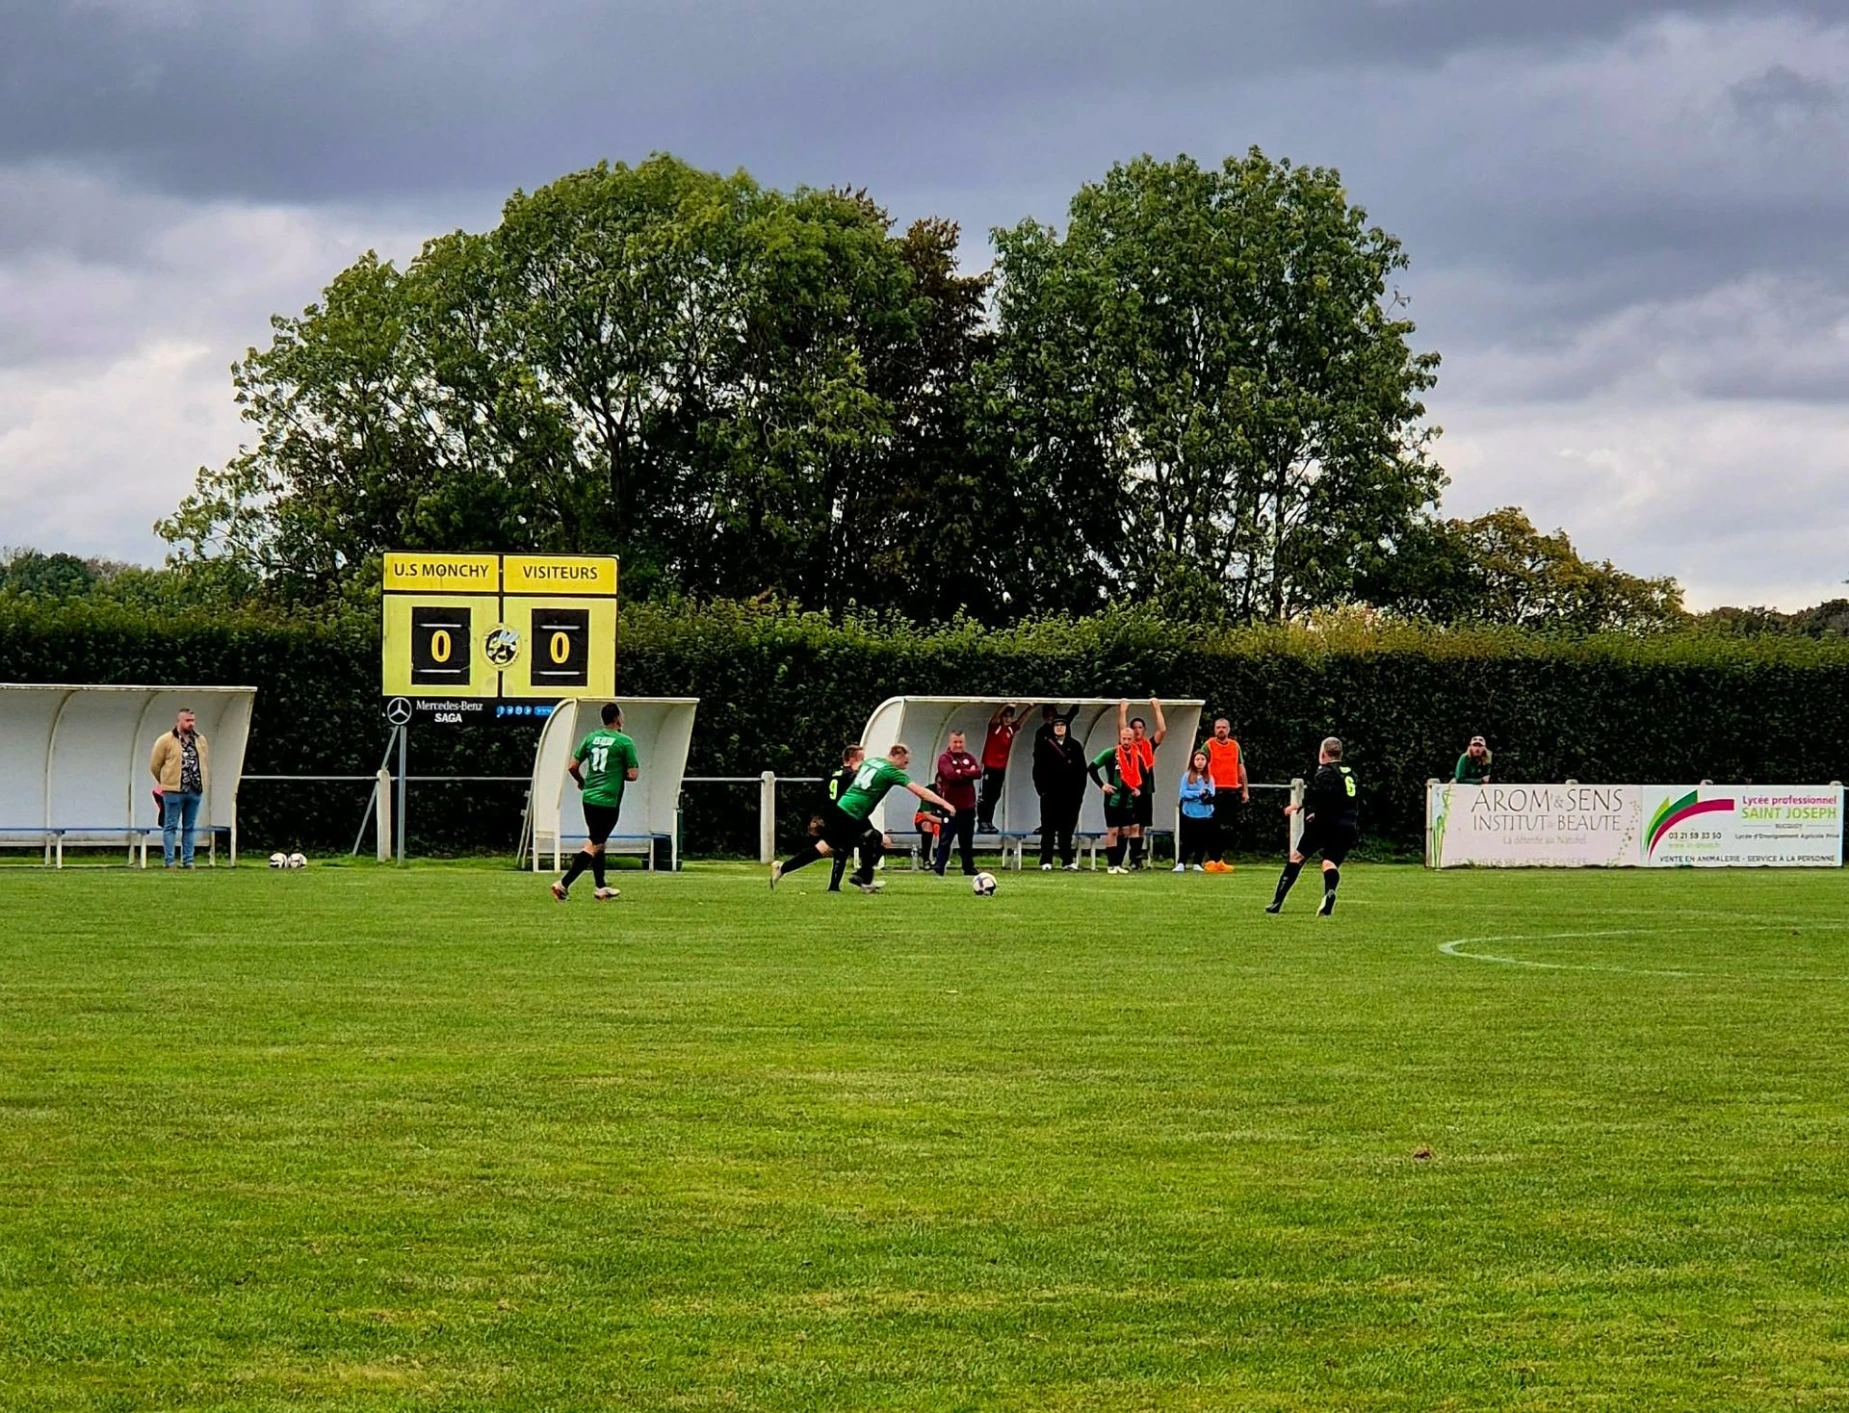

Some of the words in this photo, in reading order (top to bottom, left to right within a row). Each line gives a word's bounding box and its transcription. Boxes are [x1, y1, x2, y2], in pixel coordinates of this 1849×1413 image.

[394, 563, 418, 577] U.S
[422, 563, 489, 578] MONCHY
[523, 565, 598, 580] VISITEURS
[430, 629, 452, 663] 0
[549, 631, 570, 664] 0
[416, 700, 483, 711] Mercedes-Benz
[434, 713, 462, 723] SAGA
[591, 747, 608, 772] 11
[829, 779, 838, 800] 9
[1344, 775, 1356, 797] 6
[1471, 788, 1550, 812] AROM
[1566, 788, 1623, 812] SENS
[1742, 795, 1770, 806] Lycée
[1772, 795, 1837, 806] professionnel
[1742, 807, 1782, 819] SAINT
[1786, 807, 1837, 819] JOSEPH
[1473, 814, 1548, 831] INSTITUT
[1558, 814, 1621, 831] BEAUTE
[1660, 855, 1683, 863] VENTE
[1697, 855, 1740, 863] ANIMALERIE
[1747, 855, 1777, 863] SERVICE
[1797, 855, 1835, 863] PERSONNE
